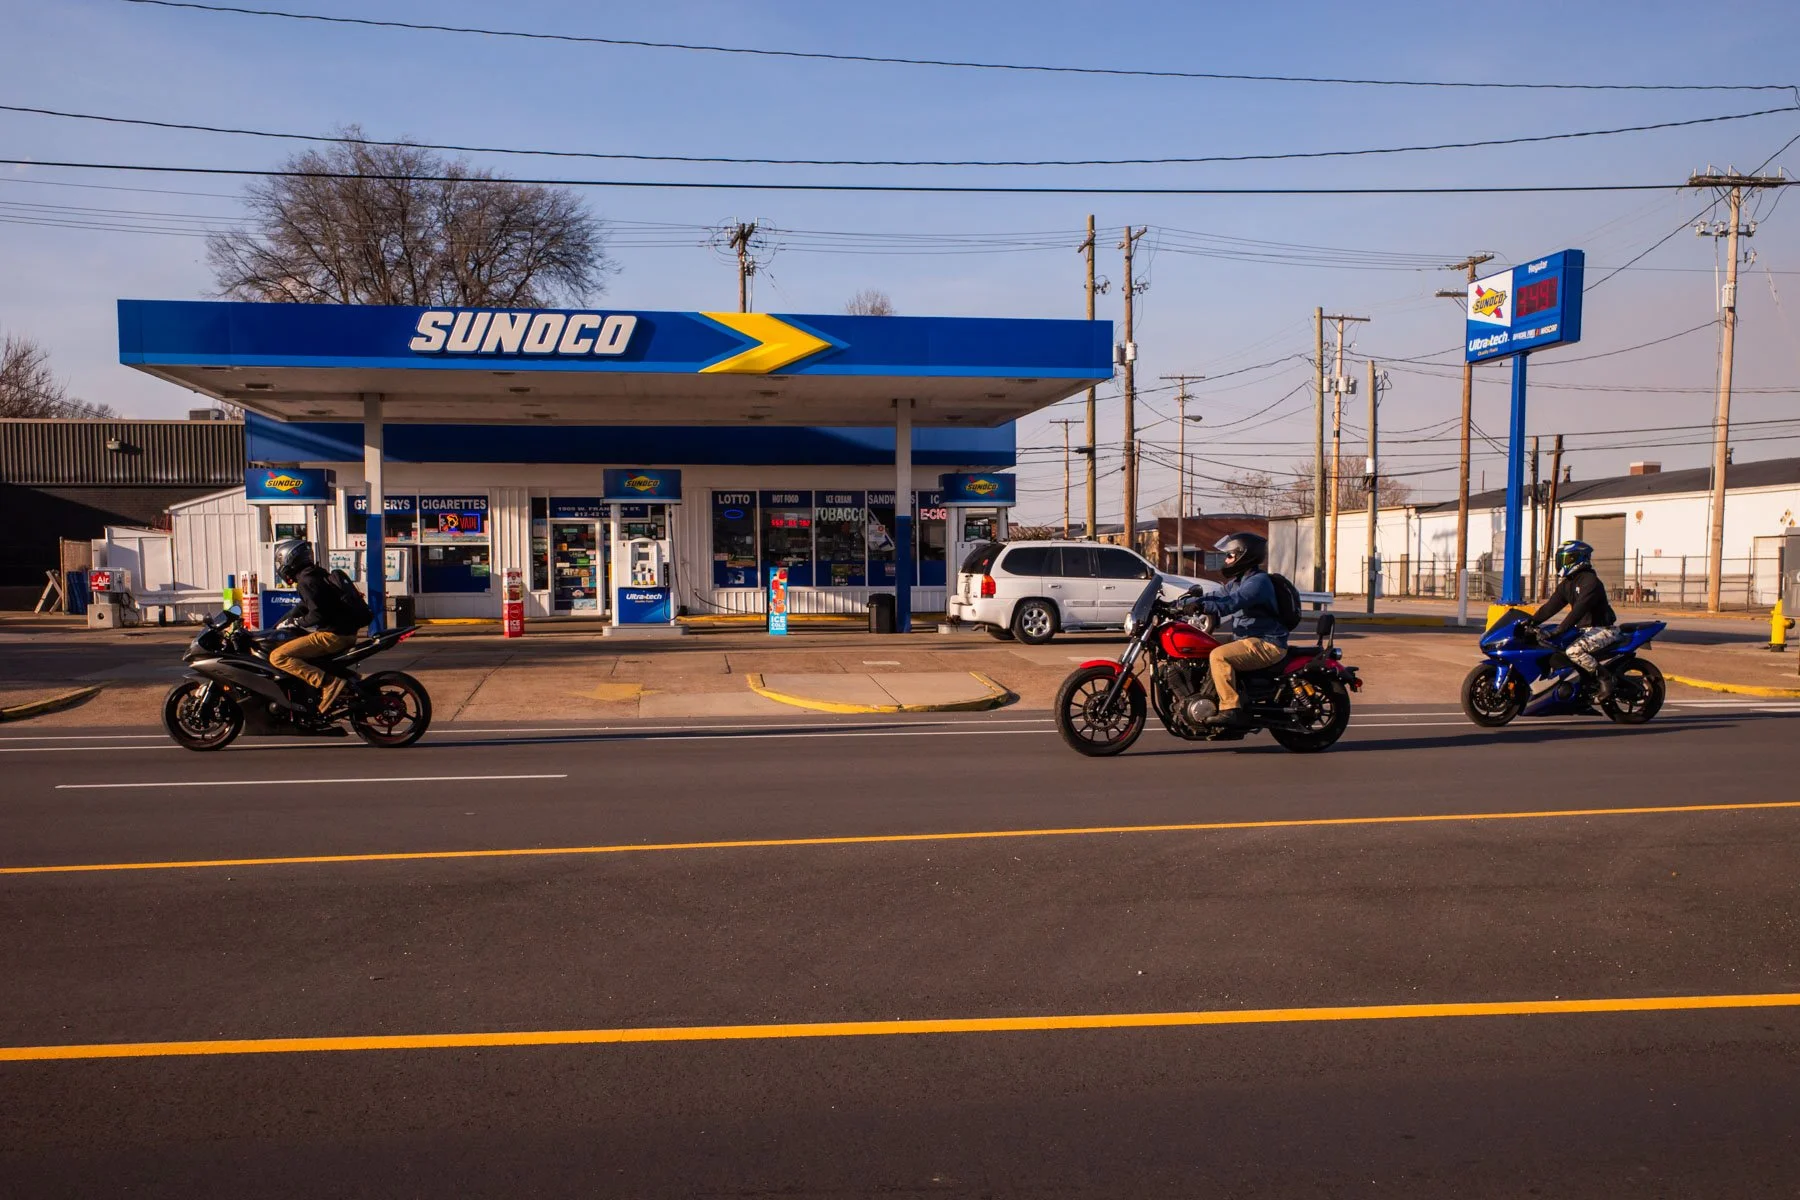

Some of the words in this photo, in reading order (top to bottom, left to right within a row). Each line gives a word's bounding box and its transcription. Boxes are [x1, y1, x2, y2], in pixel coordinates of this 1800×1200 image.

[1474, 292, 1505, 311] SUNOCO
[408, 311, 638, 355] SUNOCO
[354, 499, 411, 510] GRERYS
[421, 499, 487, 510] CIGARETTES
[718, 494, 750, 505] LOTTO
[772, 494, 783, 504] HOT
[784, 494, 799, 504] FOOD
[814, 507, 867, 521] TOBACCO
[97, 576, 110, 584] Air
